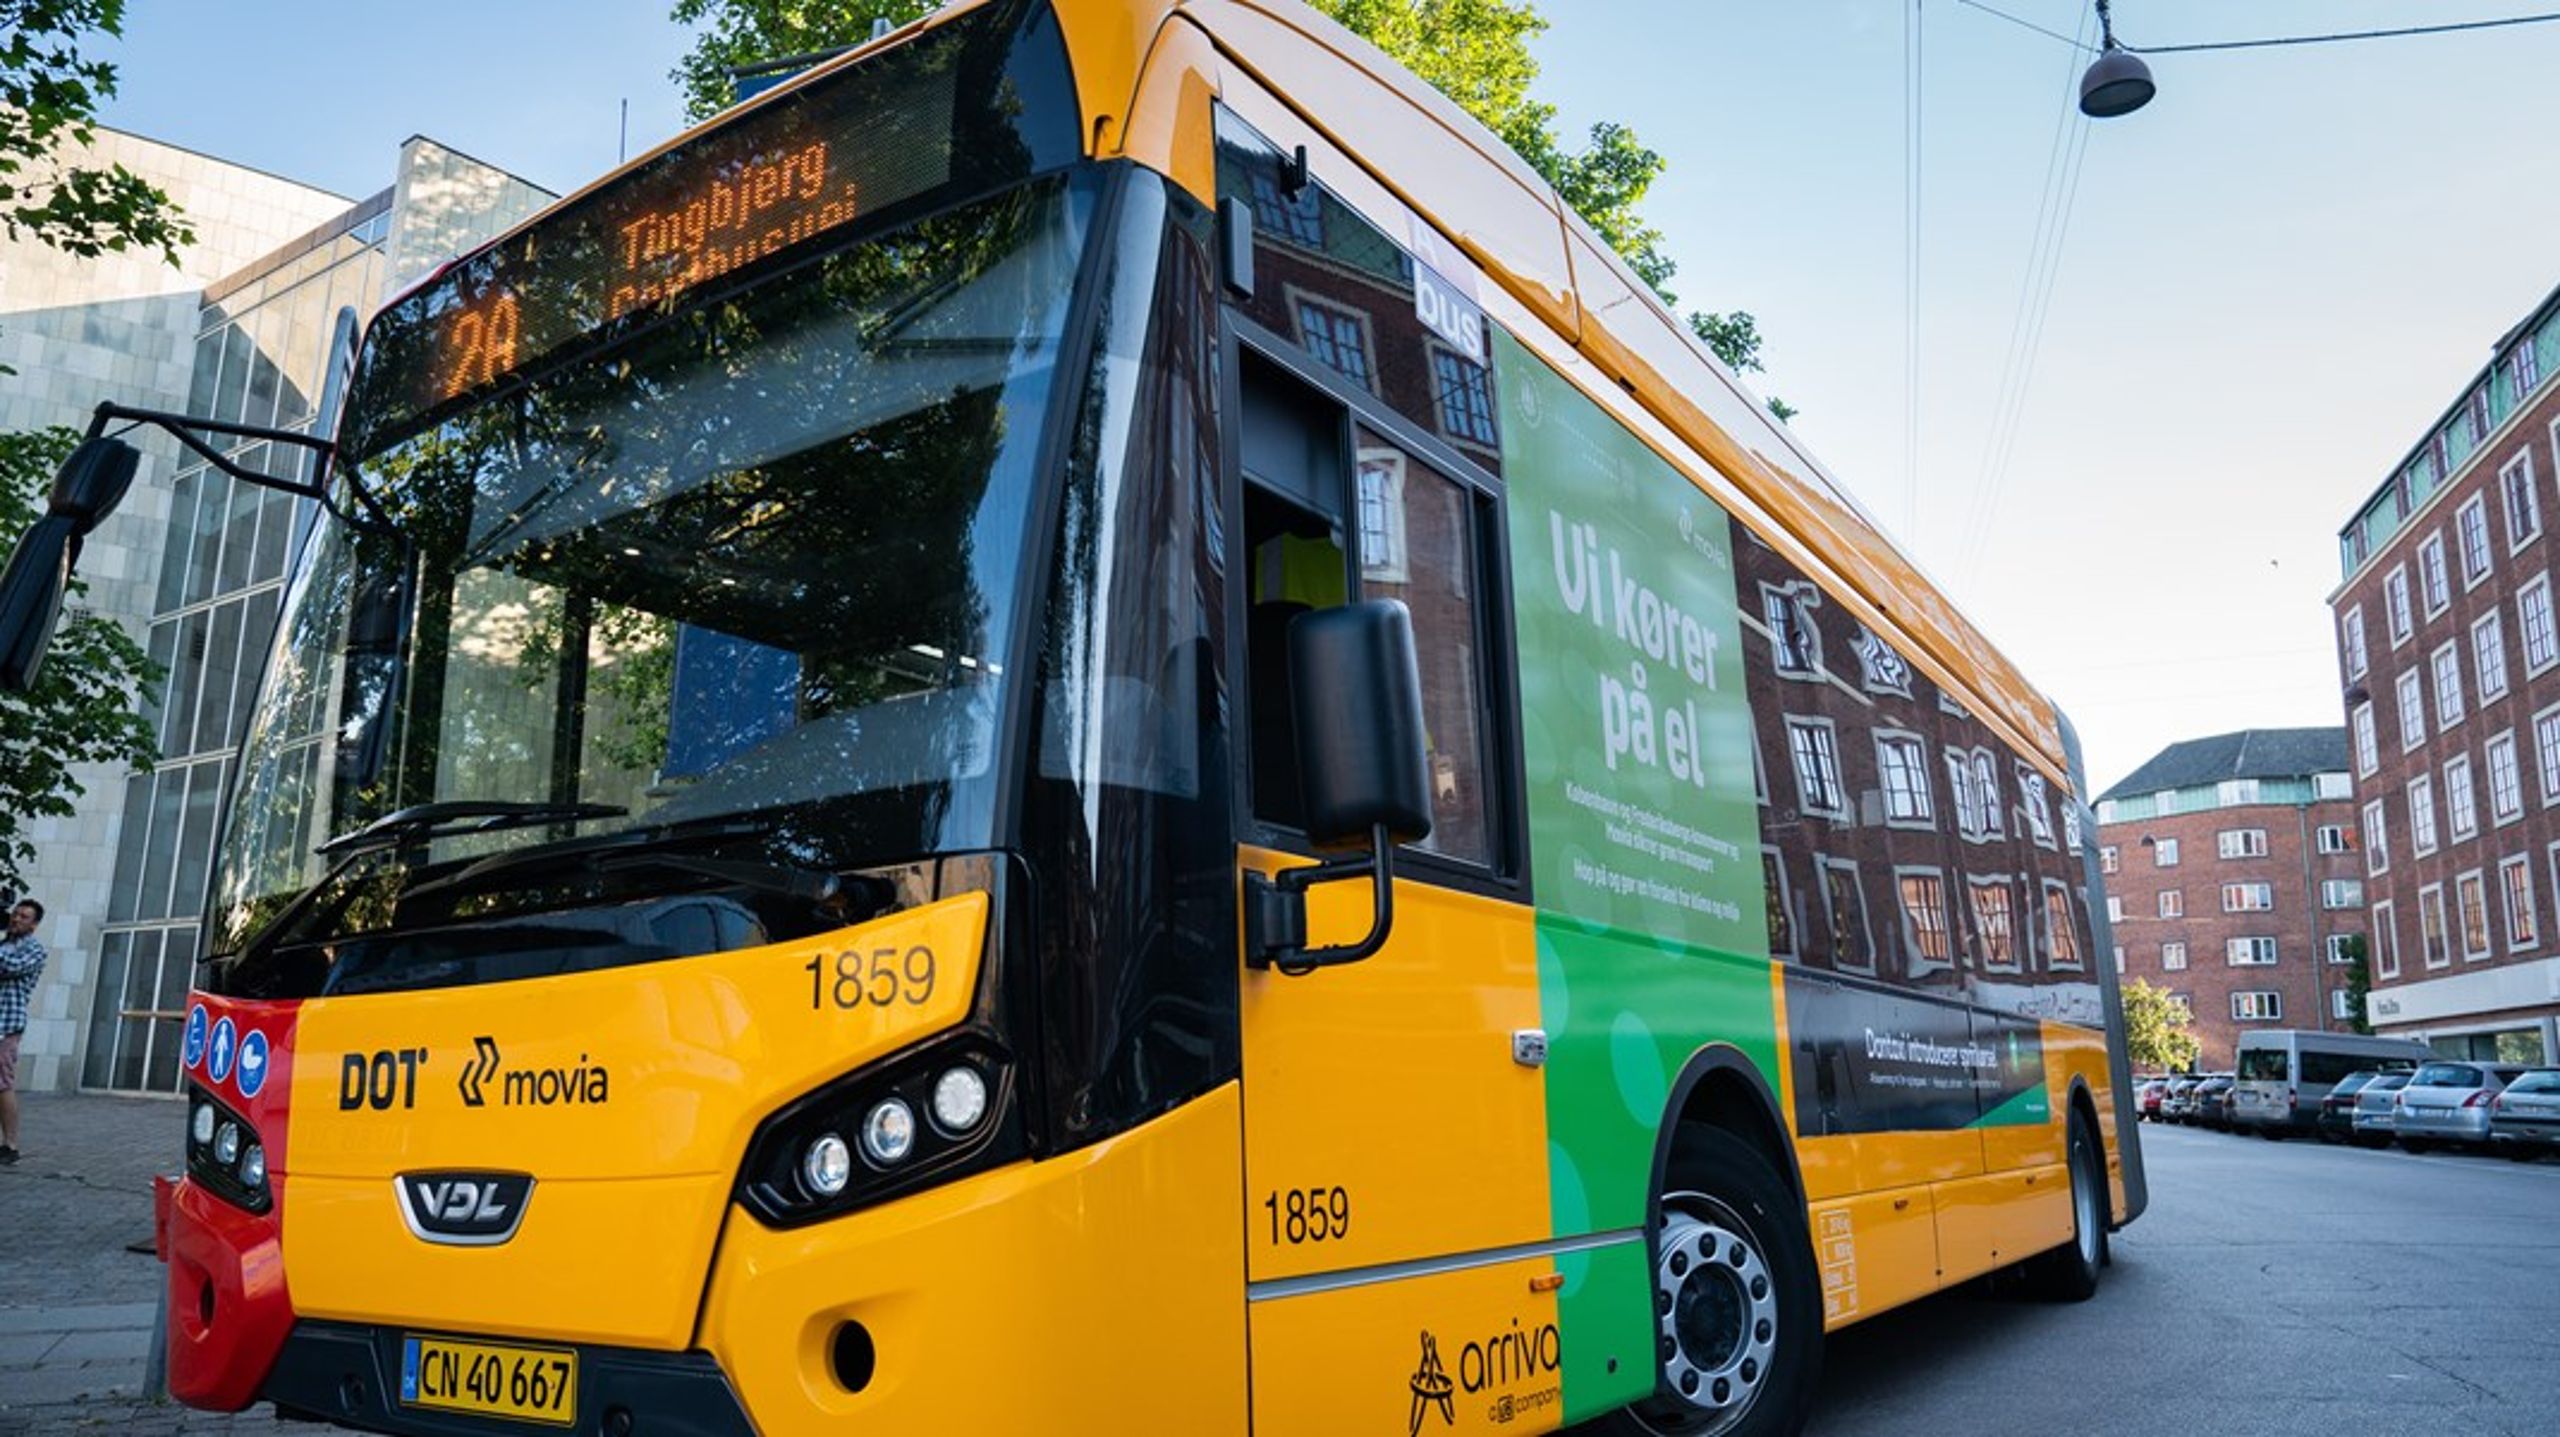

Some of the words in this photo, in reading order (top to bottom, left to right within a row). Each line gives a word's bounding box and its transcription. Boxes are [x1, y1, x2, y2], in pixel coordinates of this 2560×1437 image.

[621, 142, 826, 270] Tingbjerg
[1413, 256, 1480, 357] bus
[1550, 508, 1604, 629] Vi
[1609, 548, 1718, 692] kører
[1600, 660, 1657, 771] på
[1664, 698, 1705, 788] el
[805, 945, 936, 1010] 1859
[503, 1053, 608, 1105] movia
[416, 1181, 507, 1222] VDL
[1264, 1186, 1349, 1246] 1859
[422, 1349, 460, 1398] CN
[465, 1353, 503, 1404] 40
[511, 1357, 571, 1411] 667
[1459, 1317, 1561, 1393] arriva
